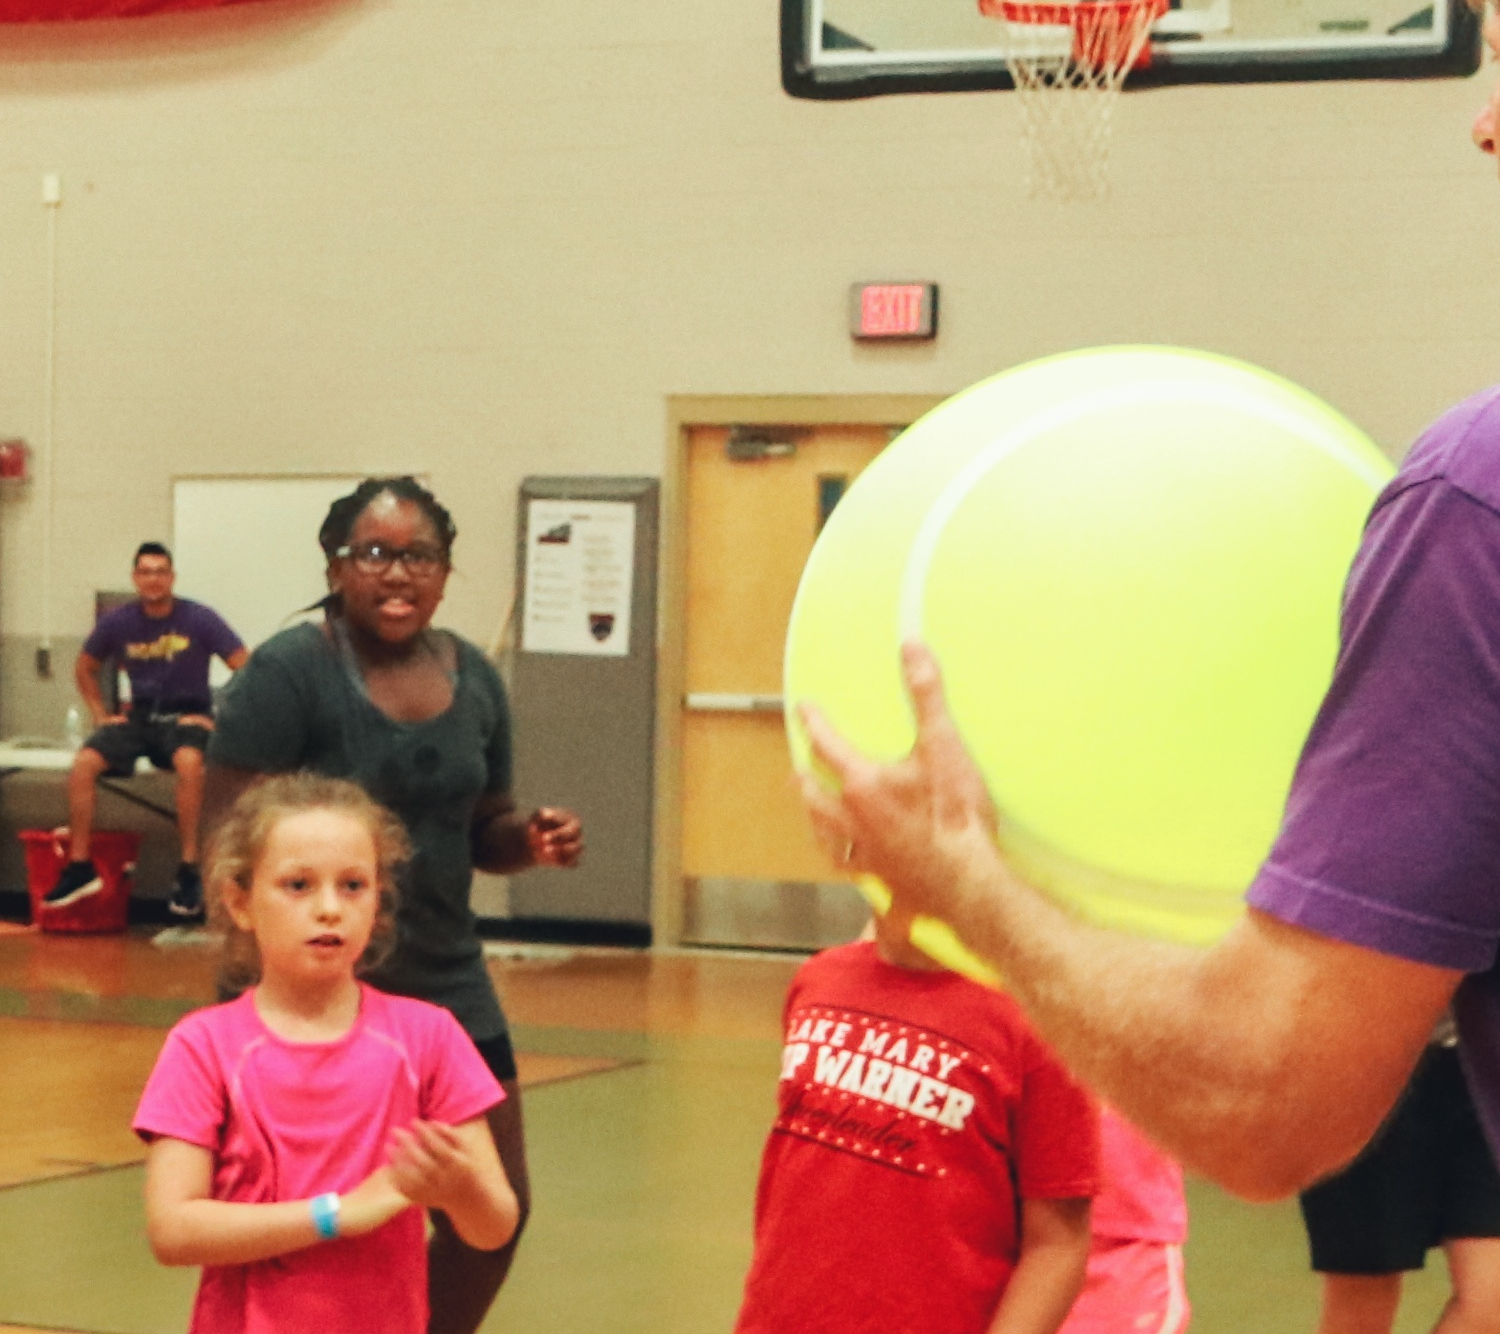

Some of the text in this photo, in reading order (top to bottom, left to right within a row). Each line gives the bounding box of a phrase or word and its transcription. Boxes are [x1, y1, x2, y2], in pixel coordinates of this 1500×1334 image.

[864, 287, 923, 331] EXIT
[787, 1018, 961, 1081] LAKE MARY
[813, 1044, 976, 1131] WARNER
